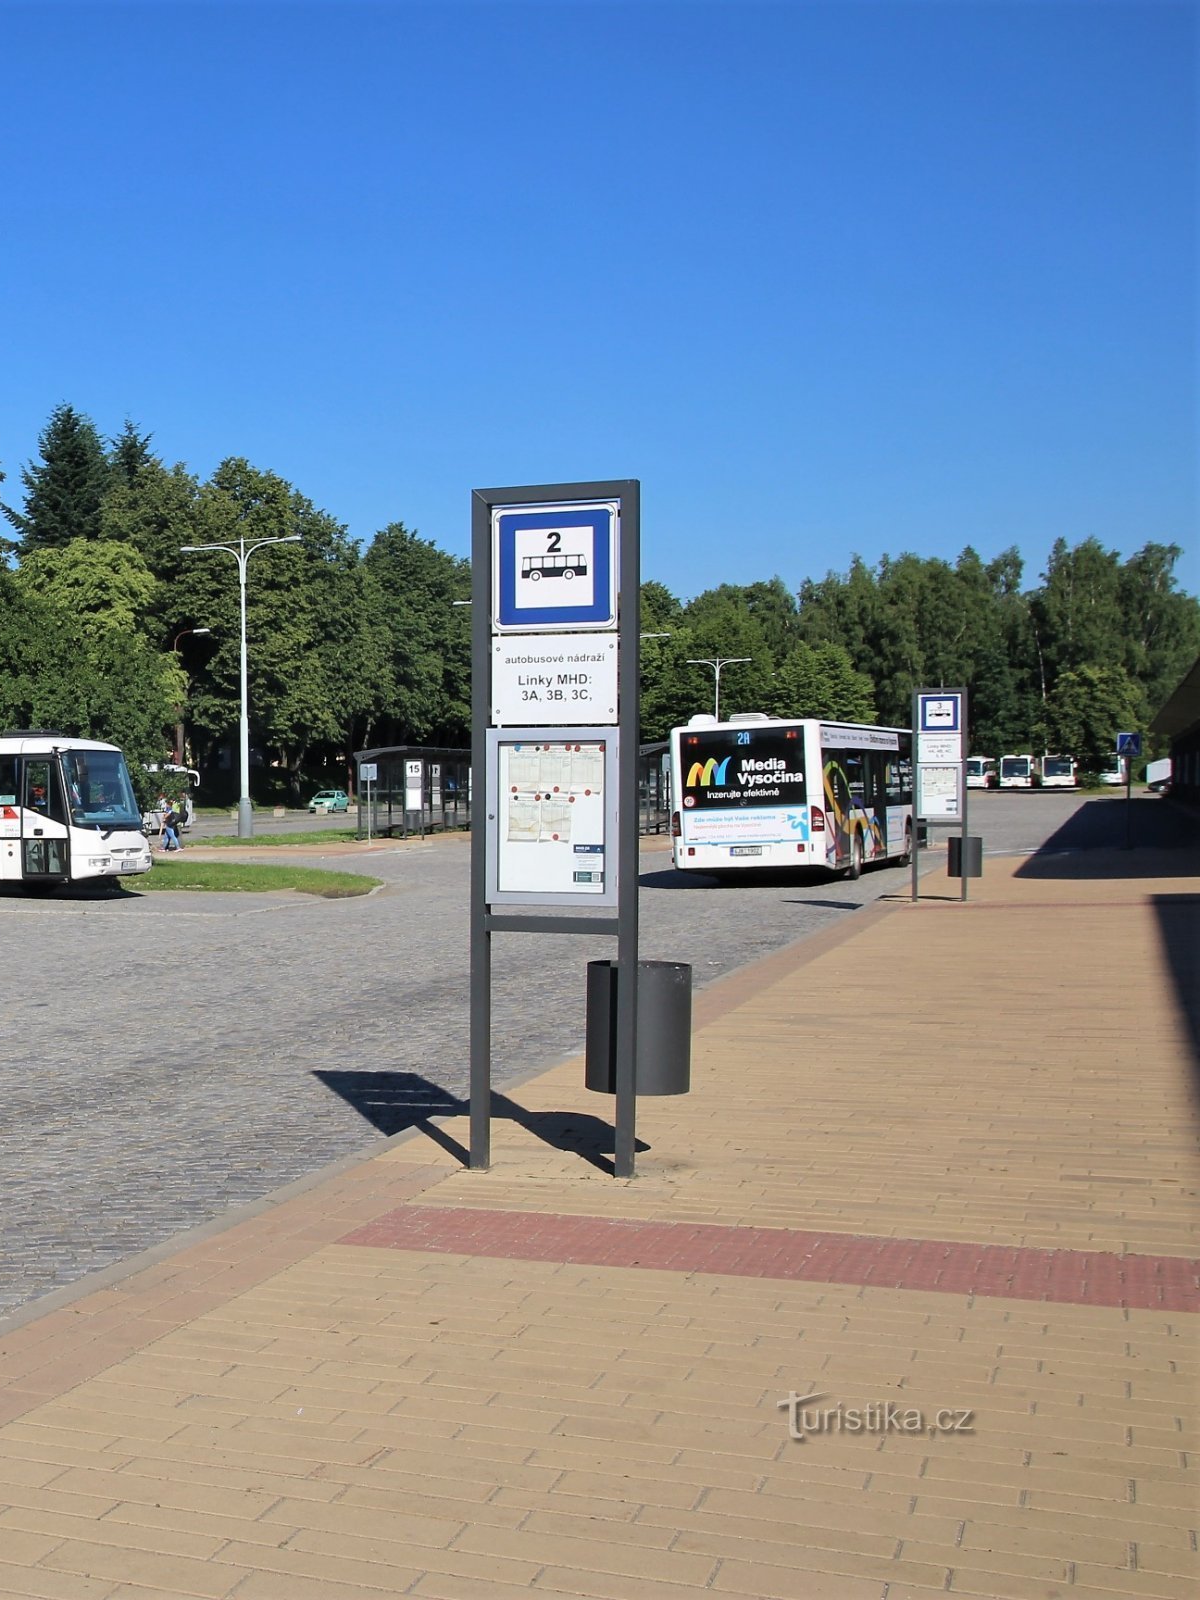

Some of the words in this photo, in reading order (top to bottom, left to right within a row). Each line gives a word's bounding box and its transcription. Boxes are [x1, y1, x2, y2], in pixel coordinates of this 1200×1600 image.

[546, 531, 562, 553] 2
[504, 653, 564, 665] autobusové
[567, 652, 606, 663] nádraží
[517, 674, 553, 688] Linky
[557, 673, 593, 685] MHD:
[521, 690, 542, 702] 3A,
[546, 689, 567, 702] 3B,
[571, 688, 593, 701] 3C,
[936, 702, 943, 710] 3
[737, 731, 750, 745] 2A
[409, 764, 420, 774] 15
[741, 757, 786, 772] Media
[737, 770, 804, 788] Vysočina
[706, 790, 742, 799] Inzerujte
[743, 787, 780, 797] efektivně
